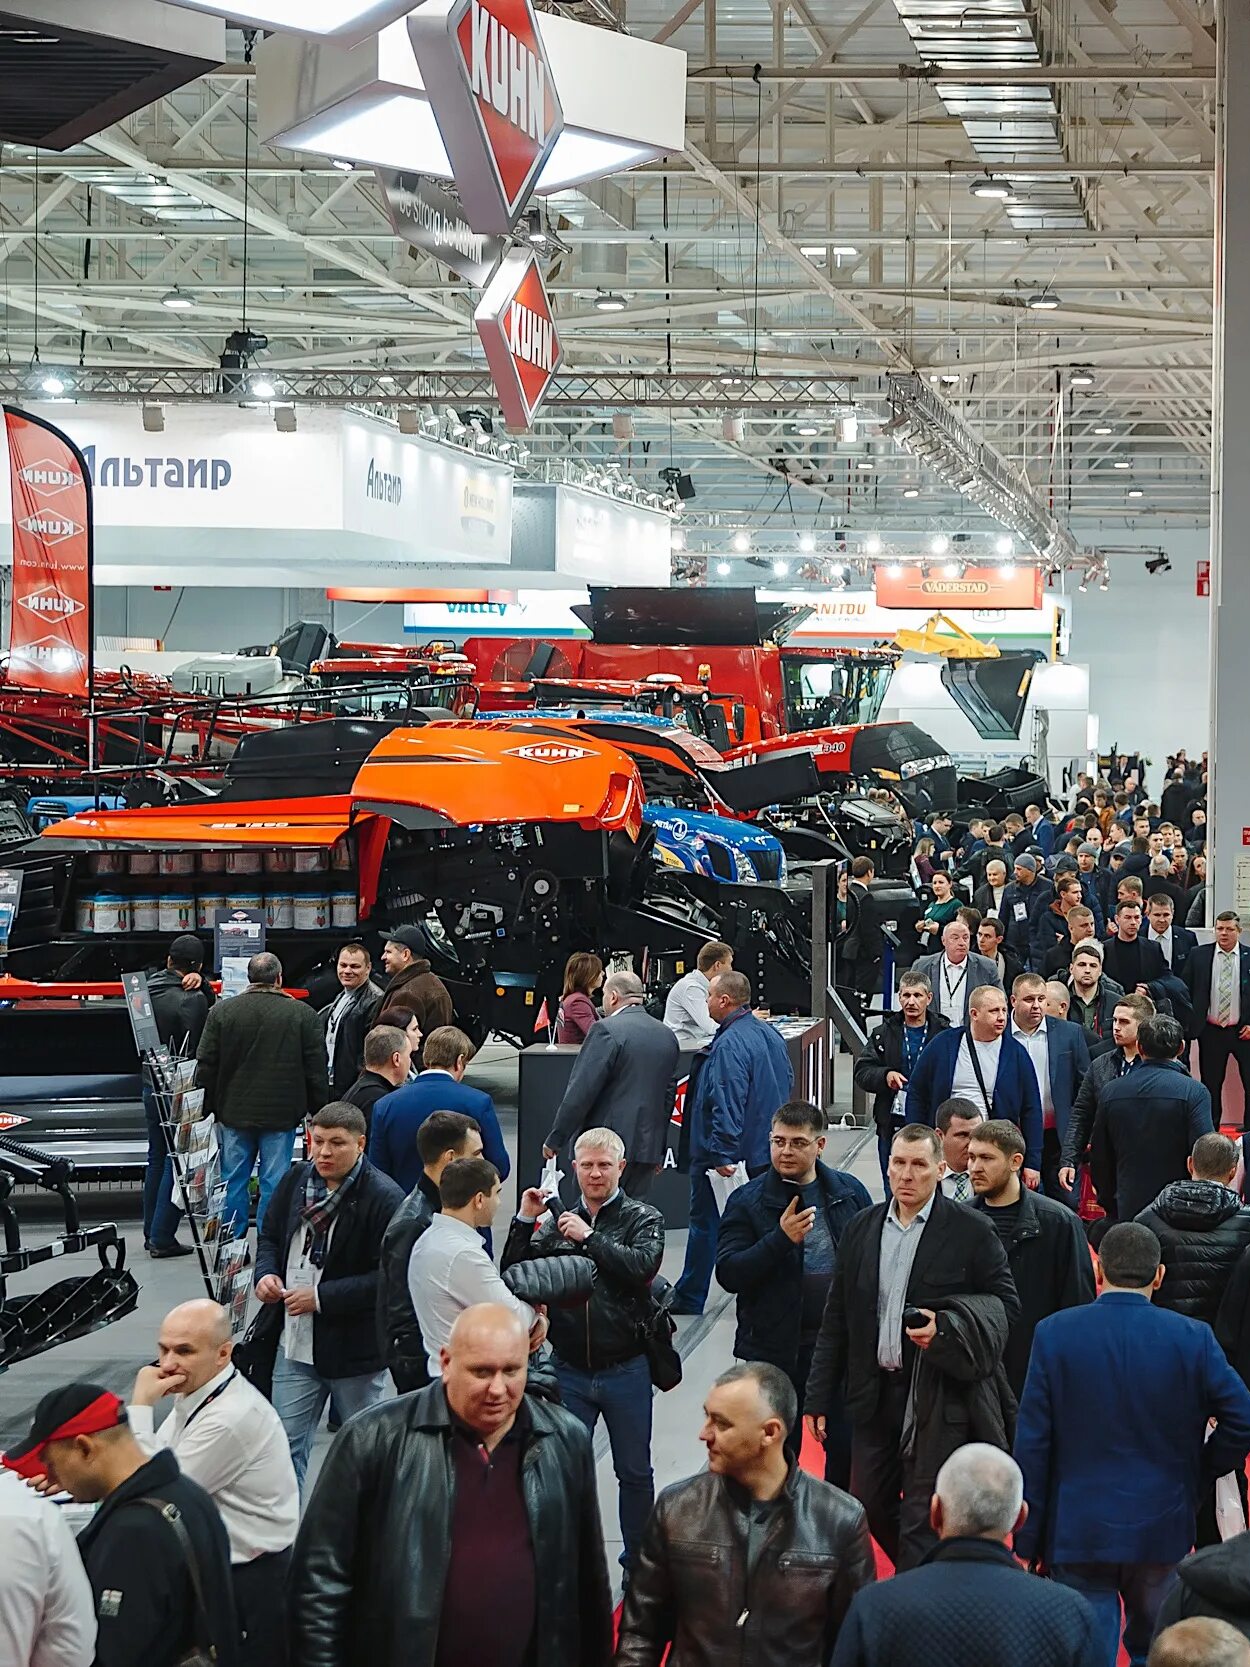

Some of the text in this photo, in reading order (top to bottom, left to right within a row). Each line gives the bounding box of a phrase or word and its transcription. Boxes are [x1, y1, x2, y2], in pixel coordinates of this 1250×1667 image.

[472, 3, 545, 147] KUHN
[510, 299, 552, 373] KUHN
[367, 457, 401, 506] Альтаир
[925, 581, 987, 592] VÄDERSTAD
[812, 604, 866, 615] ANITOU
[518, 748, 584, 758] KUHN
[822, 742, 846, 754] 340
